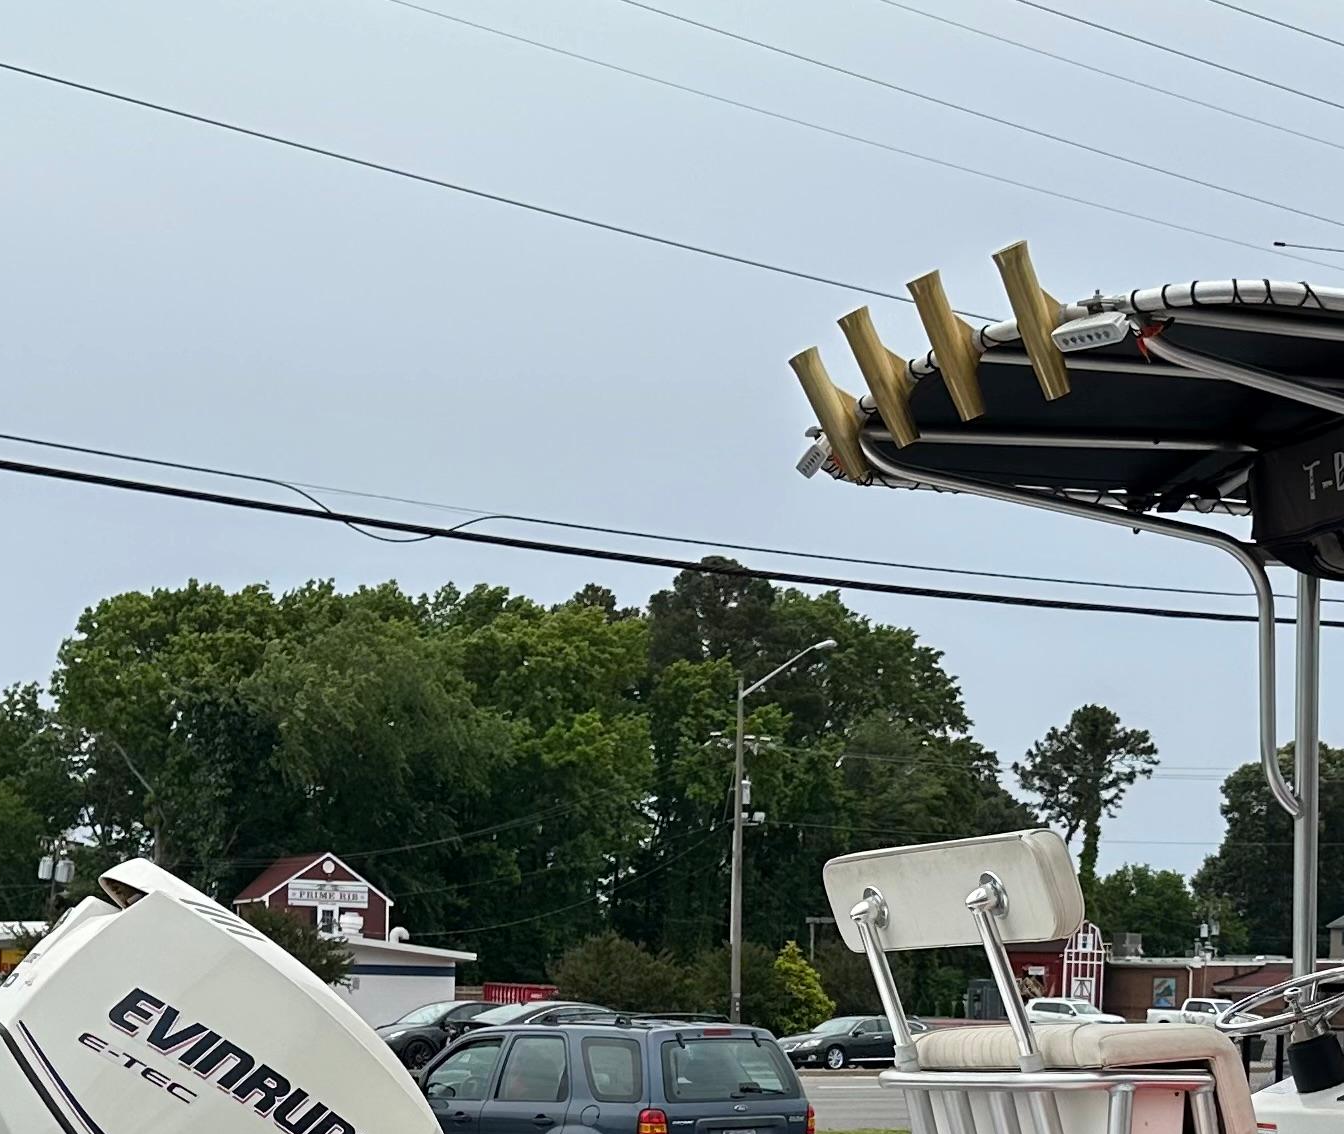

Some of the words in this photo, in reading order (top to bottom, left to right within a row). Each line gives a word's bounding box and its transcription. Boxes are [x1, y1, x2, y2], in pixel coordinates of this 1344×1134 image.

[299, 891, 336, 900] PRIME
[339, 892, 359, 901] RIB
[77, 1031, 198, 1104] E-TEC
